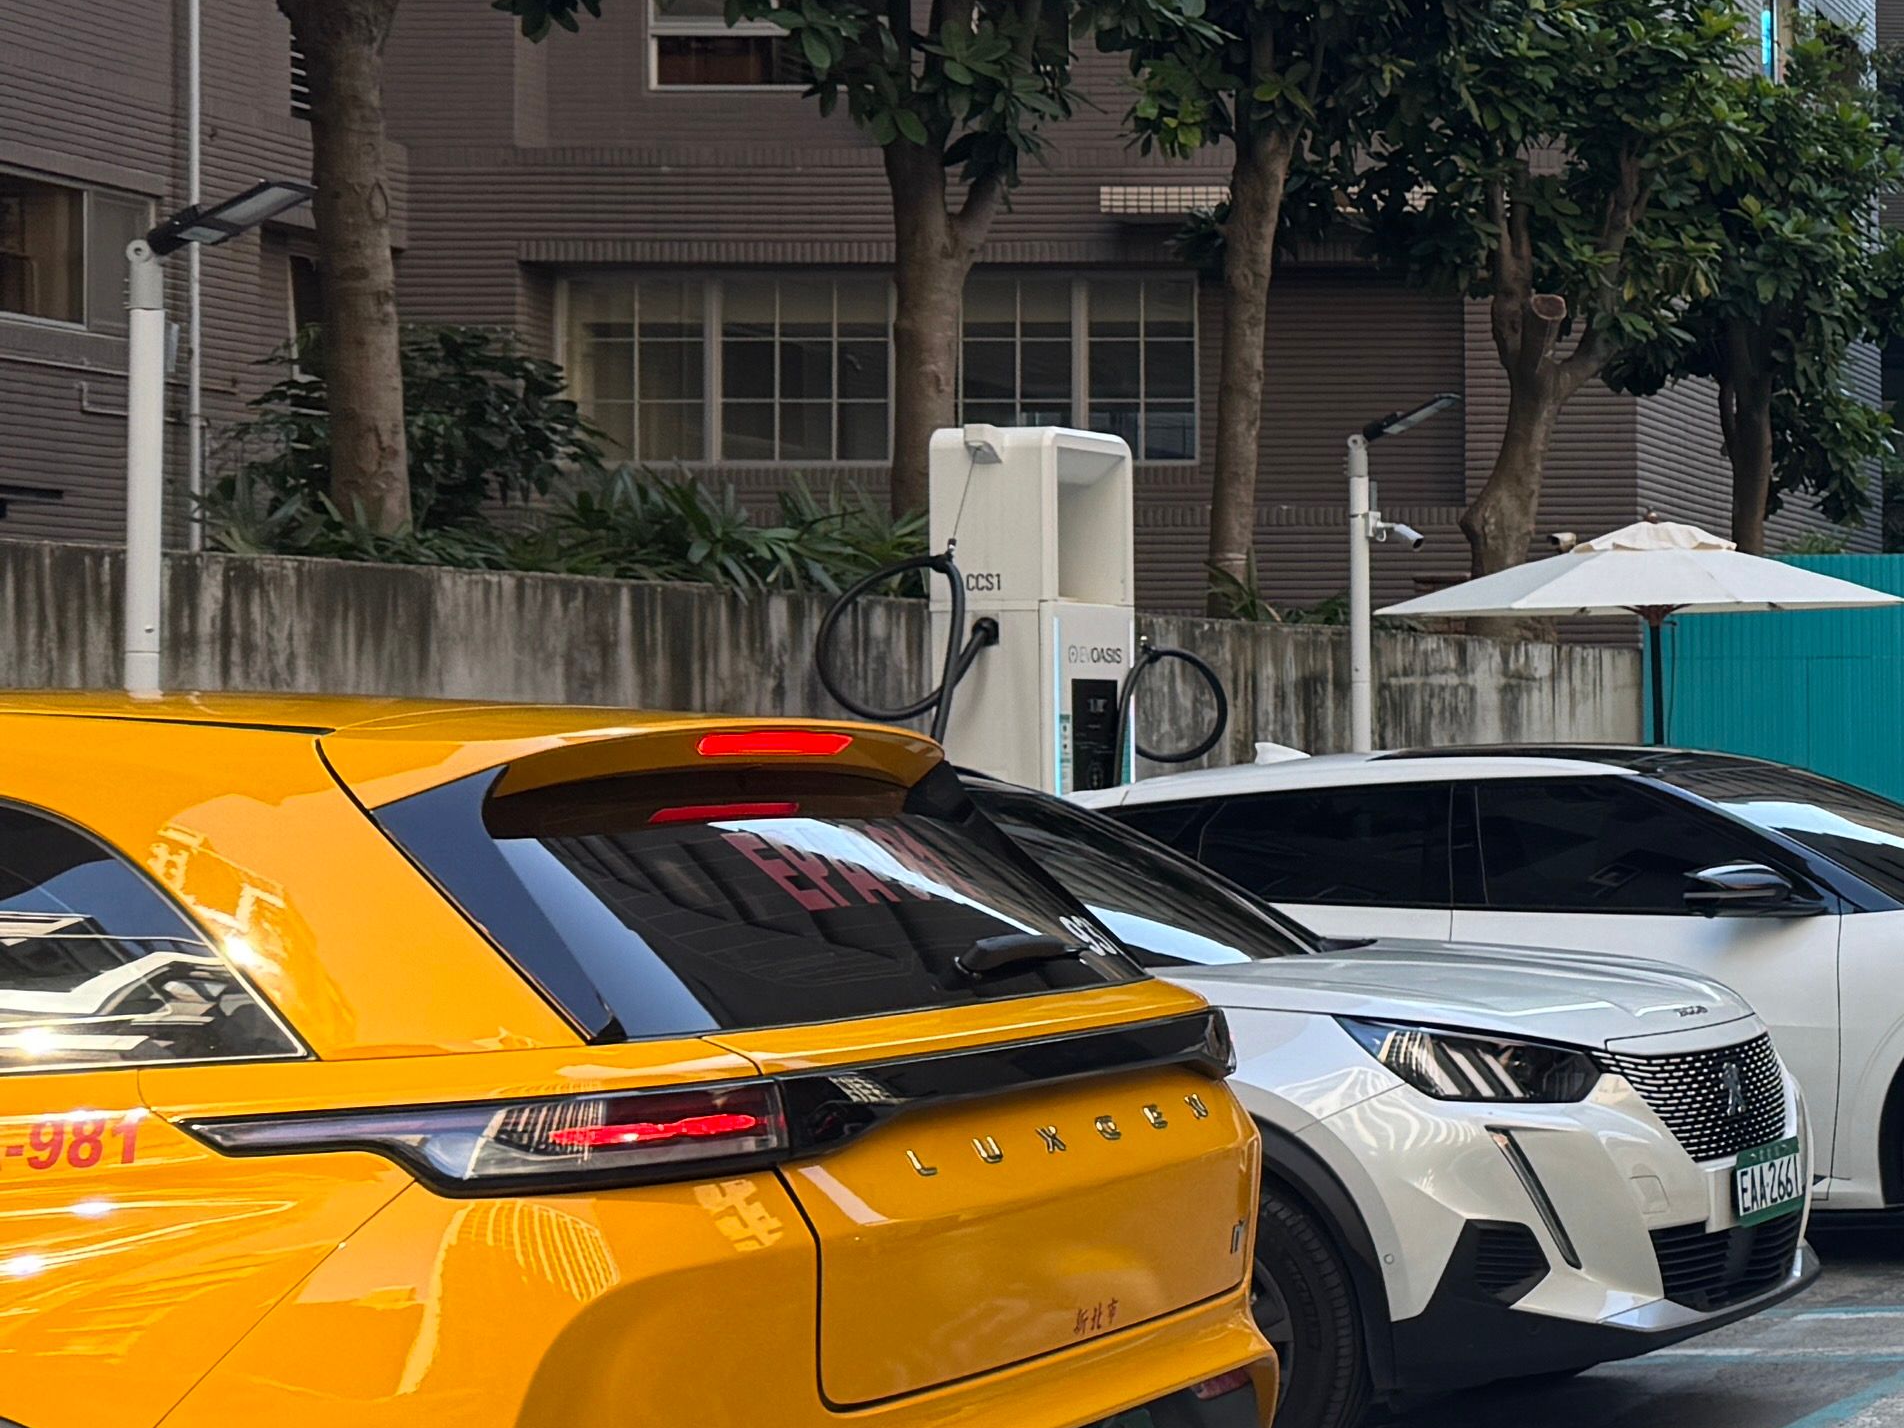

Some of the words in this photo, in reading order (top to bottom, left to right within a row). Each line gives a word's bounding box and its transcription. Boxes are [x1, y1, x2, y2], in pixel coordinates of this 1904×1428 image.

[966, 573, 1001, 592] CCS1
[0, 1118, 141, 1170] -981
[905, 1093, 1209, 1177] LUXGEN
